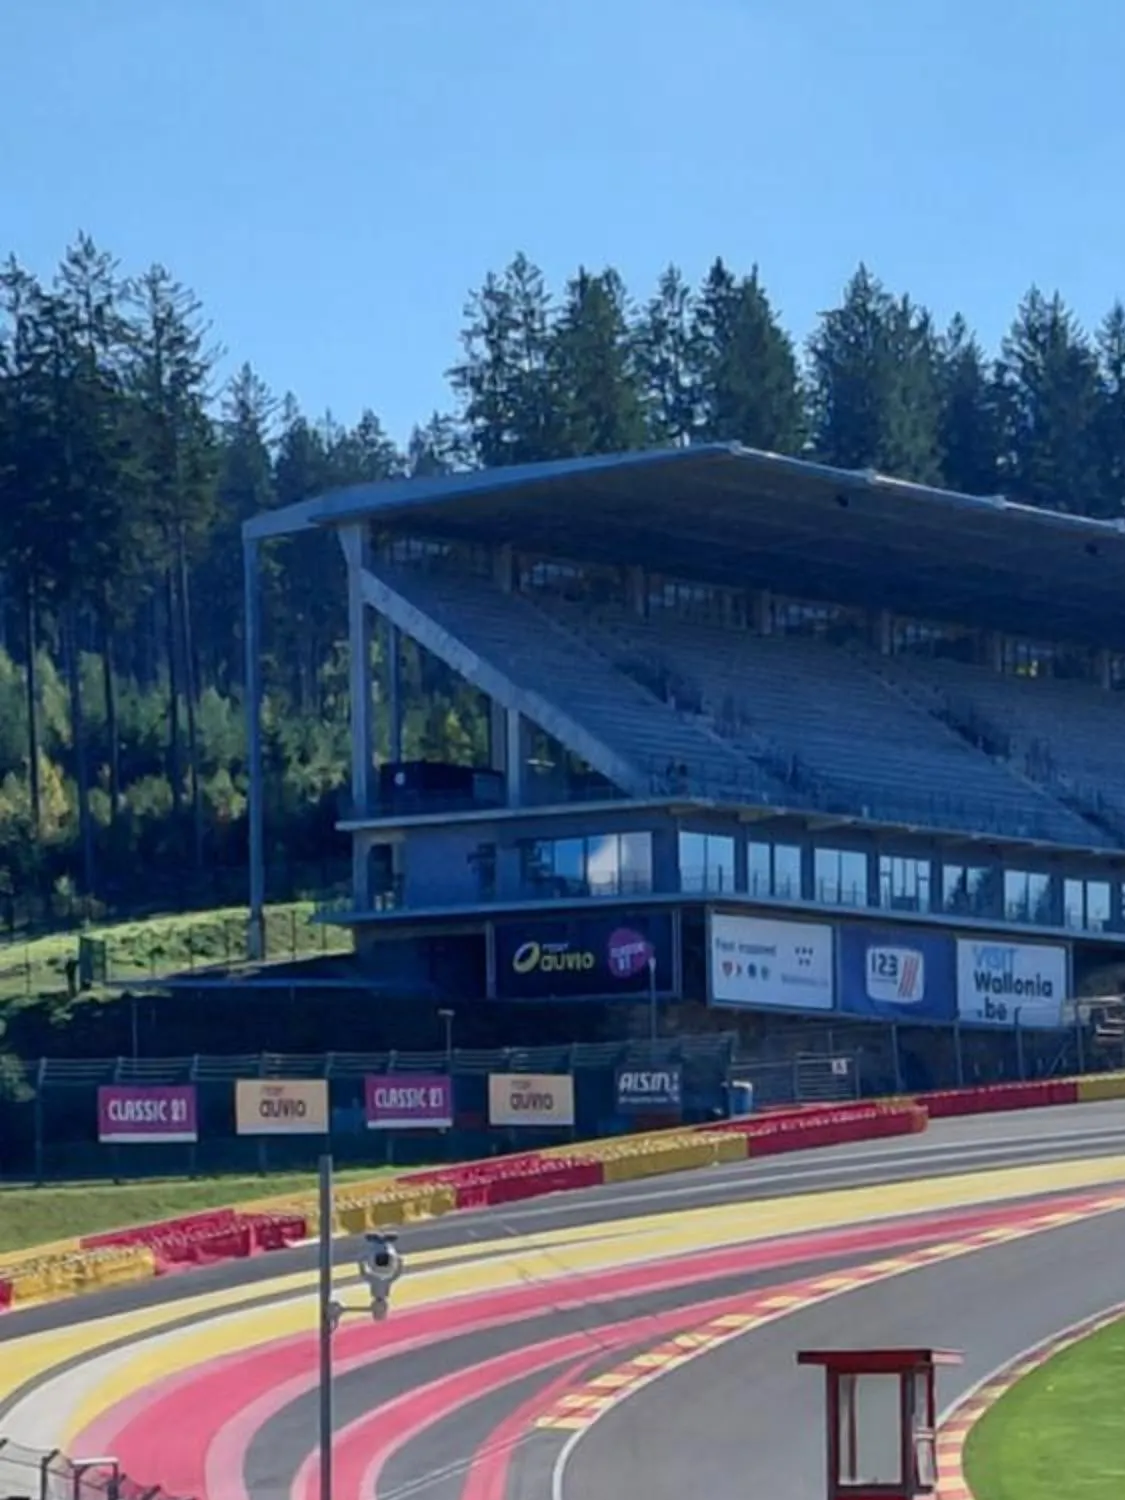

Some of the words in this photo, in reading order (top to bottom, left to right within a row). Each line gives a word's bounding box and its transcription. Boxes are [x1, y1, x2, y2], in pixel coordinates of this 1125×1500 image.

[540, 951, 595, 972] auvio
[871, 953, 898, 977] 123
[973, 970, 1053, 997] Wallonia
[374, 1088, 427, 1108] CLASSIC
[510, 1093, 554, 1111] auvio
[107, 1099, 166, 1122] CLASSIC
[170, 1098, 187, 1121] 21
[259, 1100, 306, 1119] auvio
